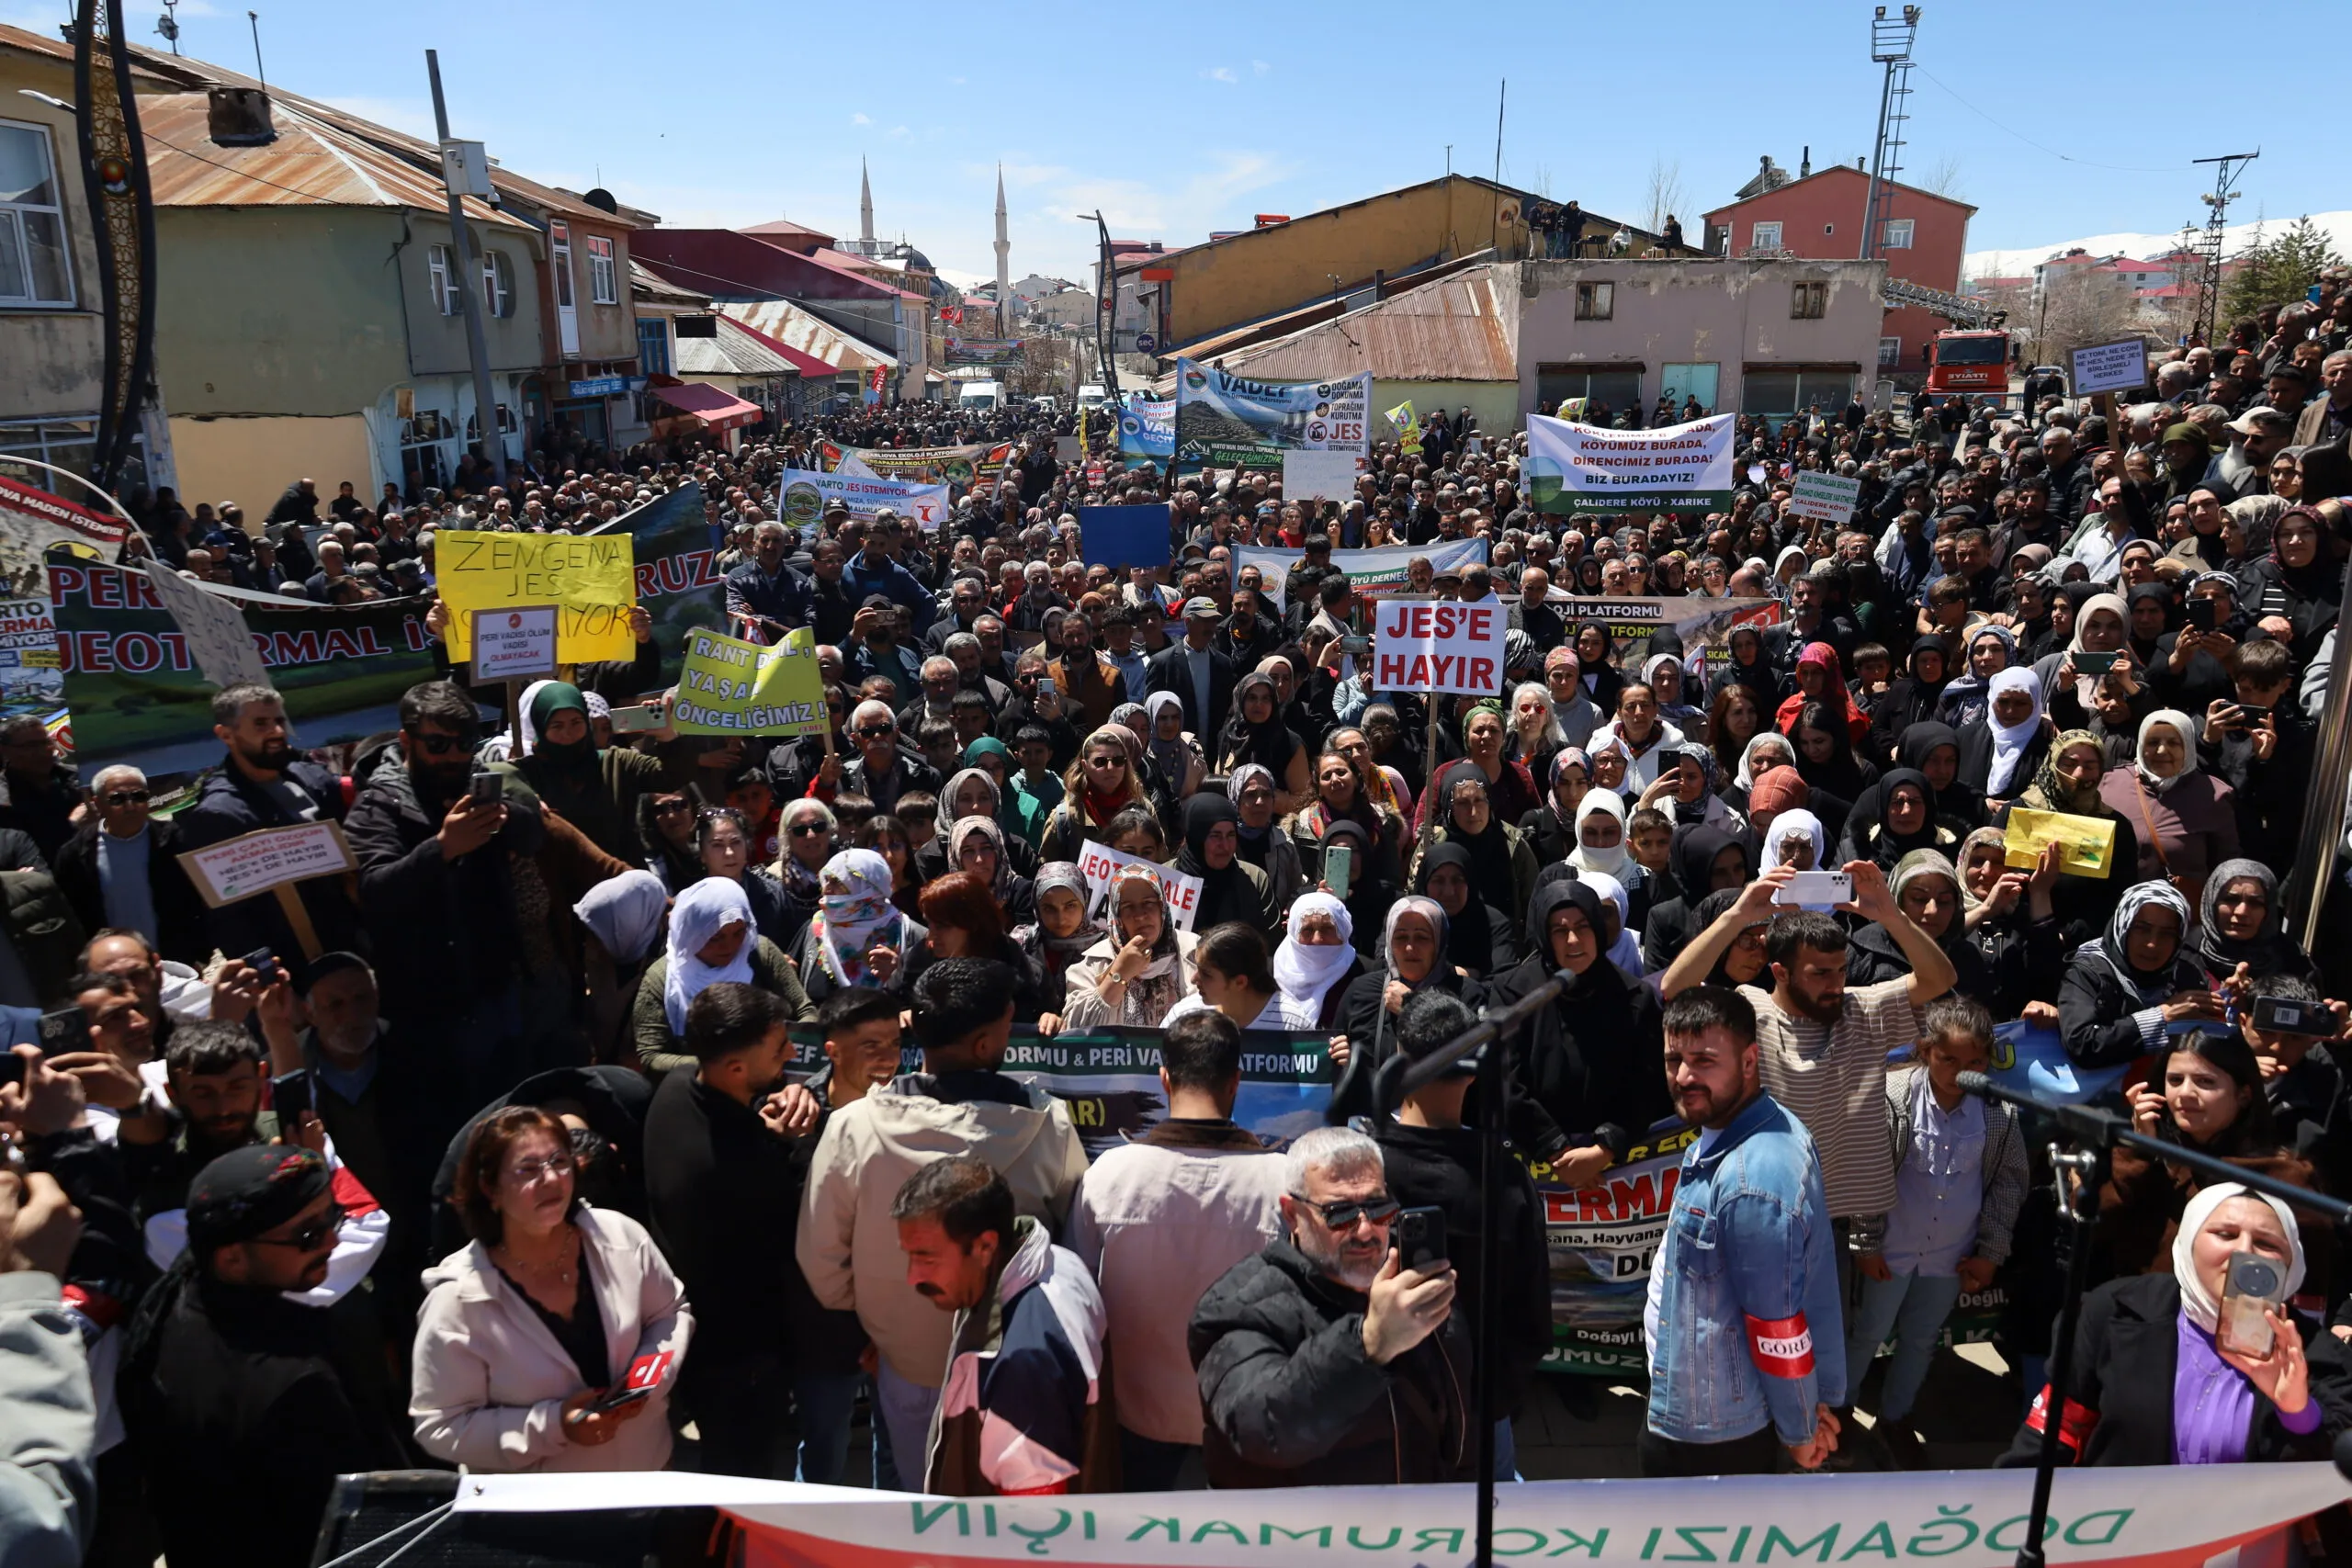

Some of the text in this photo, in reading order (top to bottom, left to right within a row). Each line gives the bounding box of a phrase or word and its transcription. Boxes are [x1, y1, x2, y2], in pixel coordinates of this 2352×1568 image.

[1138, 338, 1153, 346] sec
[1331, 380, 1363, 390] DOĞAMA
[1331, 390, 1363, 400] DOKUNMA
[1331, 401, 1364, 412] TOPRAĞIMI
[1330, 412, 1363, 421] KURUTMA
[1329, 423, 1362, 440] JES
[1143, 433, 1173, 444] GEÇİT
[1580, 439, 1707, 451] KÖYÜMÜZ BURADA,
[1328, 444, 1362, 452] İSTEMİYORUZ
[1573, 454, 1713, 467] DİRENCİMİZ BURADA!
[1585, 472, 1694, 485] BİZ BURADAYIZ!
[816, 479, 843, 490] VARTO
[846, 482, 860, 492] JES
[1631, 497, 1662, 506] KÖYÜ
[1669, 498, 1712, 506] XARIKE
[22, 497, 71, 520] MADEN
[450, 540, 624, 571] ZENGENA
[507, 573, 563, 597] JES
[1577, 604, 1664, 617] PLATFORMU
[1386, 607, 1492, 641] JES'E
[490, 649, 540, 661] OLMAYACAK
[695, 637, 751, 667] RANT
[1380, 654, 1495, 690] HAYIR
[675, 700, 814, 729] ÖNCELİĞİMİZ
[239, 838, 271, 852] ÇAYI
[261, 853, 280, 863] DE
[284, 843, 325, 857] HAYIR
[266, 861, 284, 871] DE
[287, 851, 327, 864] HAYIR
[1073, 1054, 1084, 1066] &
[1090, 1043, 1132, 1066] PERİ
[1959, 1289, 2009, 1308] Değil,
